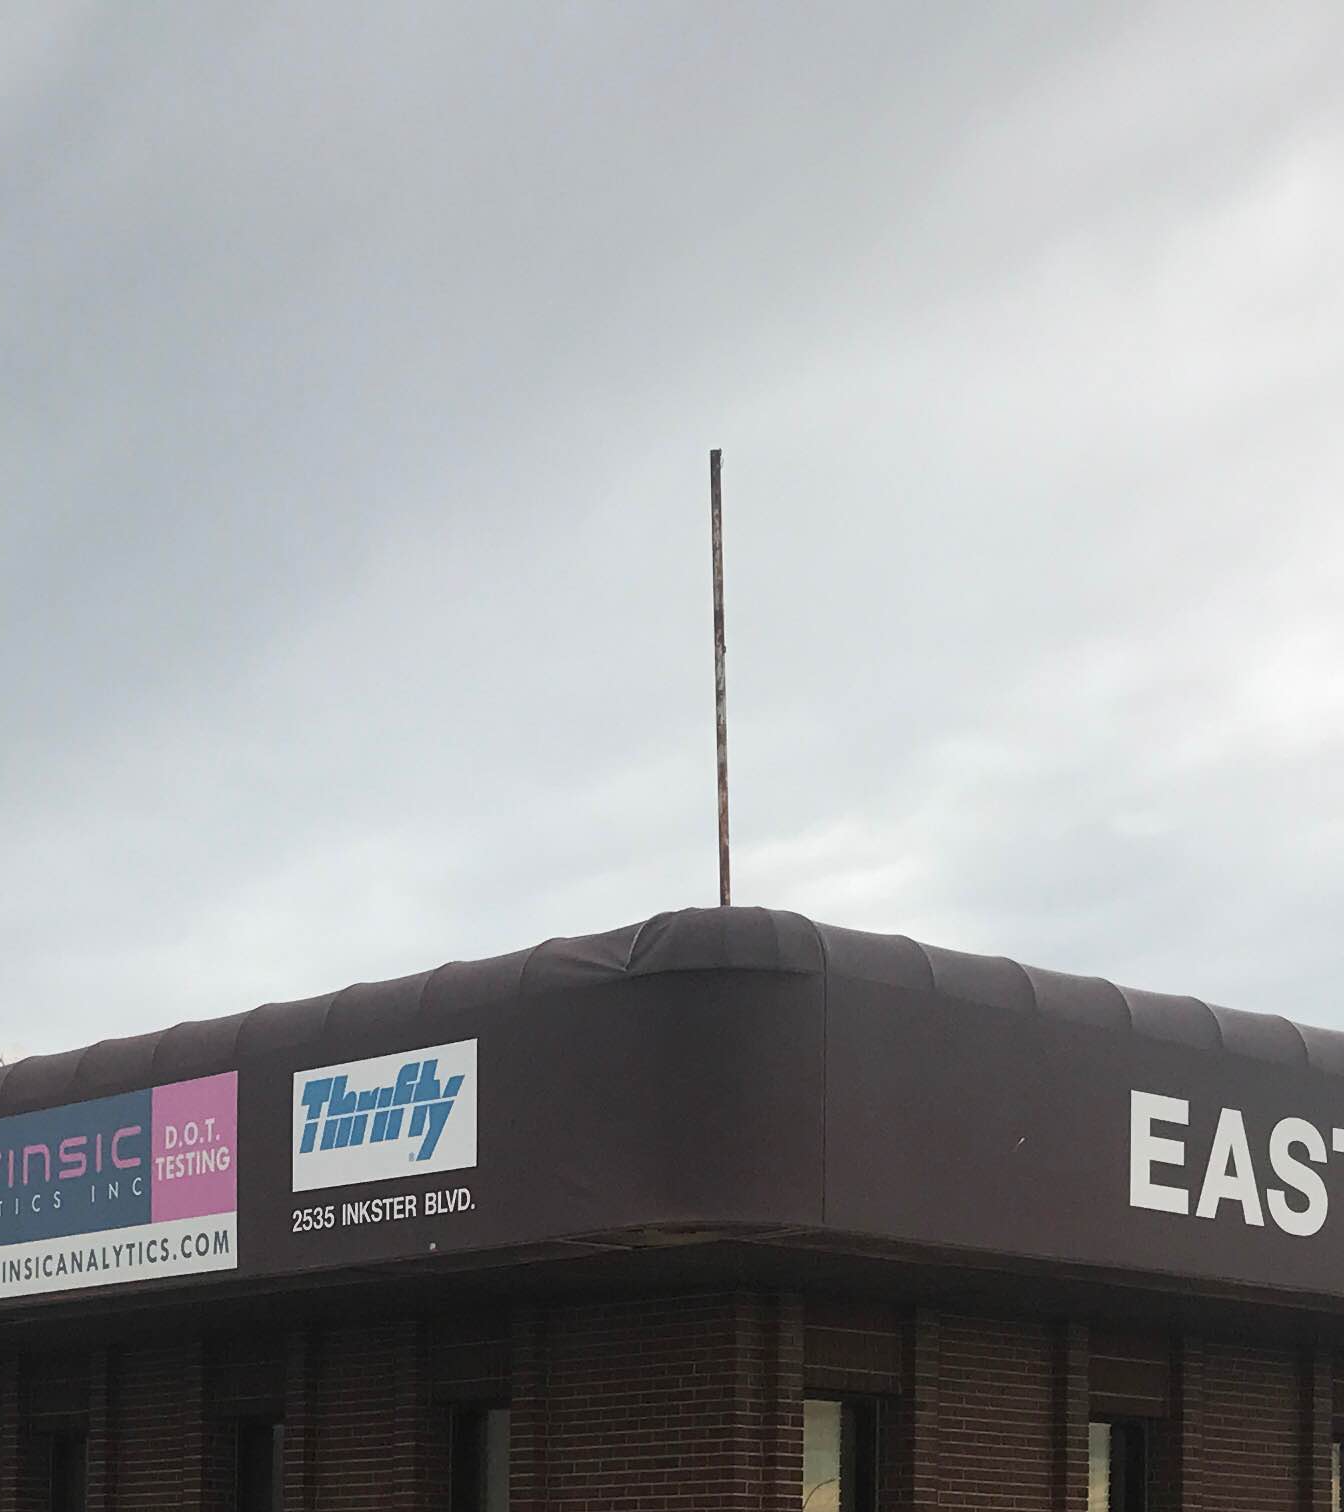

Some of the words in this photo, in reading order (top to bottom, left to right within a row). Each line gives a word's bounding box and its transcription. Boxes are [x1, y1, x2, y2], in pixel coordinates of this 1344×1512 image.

[299, 1059, 465, 1162] Thrifty
[164, 1118, 221, 1150] D.O.T.
[155, 1146, 231, 1182] TESTING
[90, 1176, 144, 1203] INC
[292, 1205, 336, 1233] 2535
[342, 1194, 417, 1226] INKSTER
[424, 1187, 476, 1216] BLVD.
